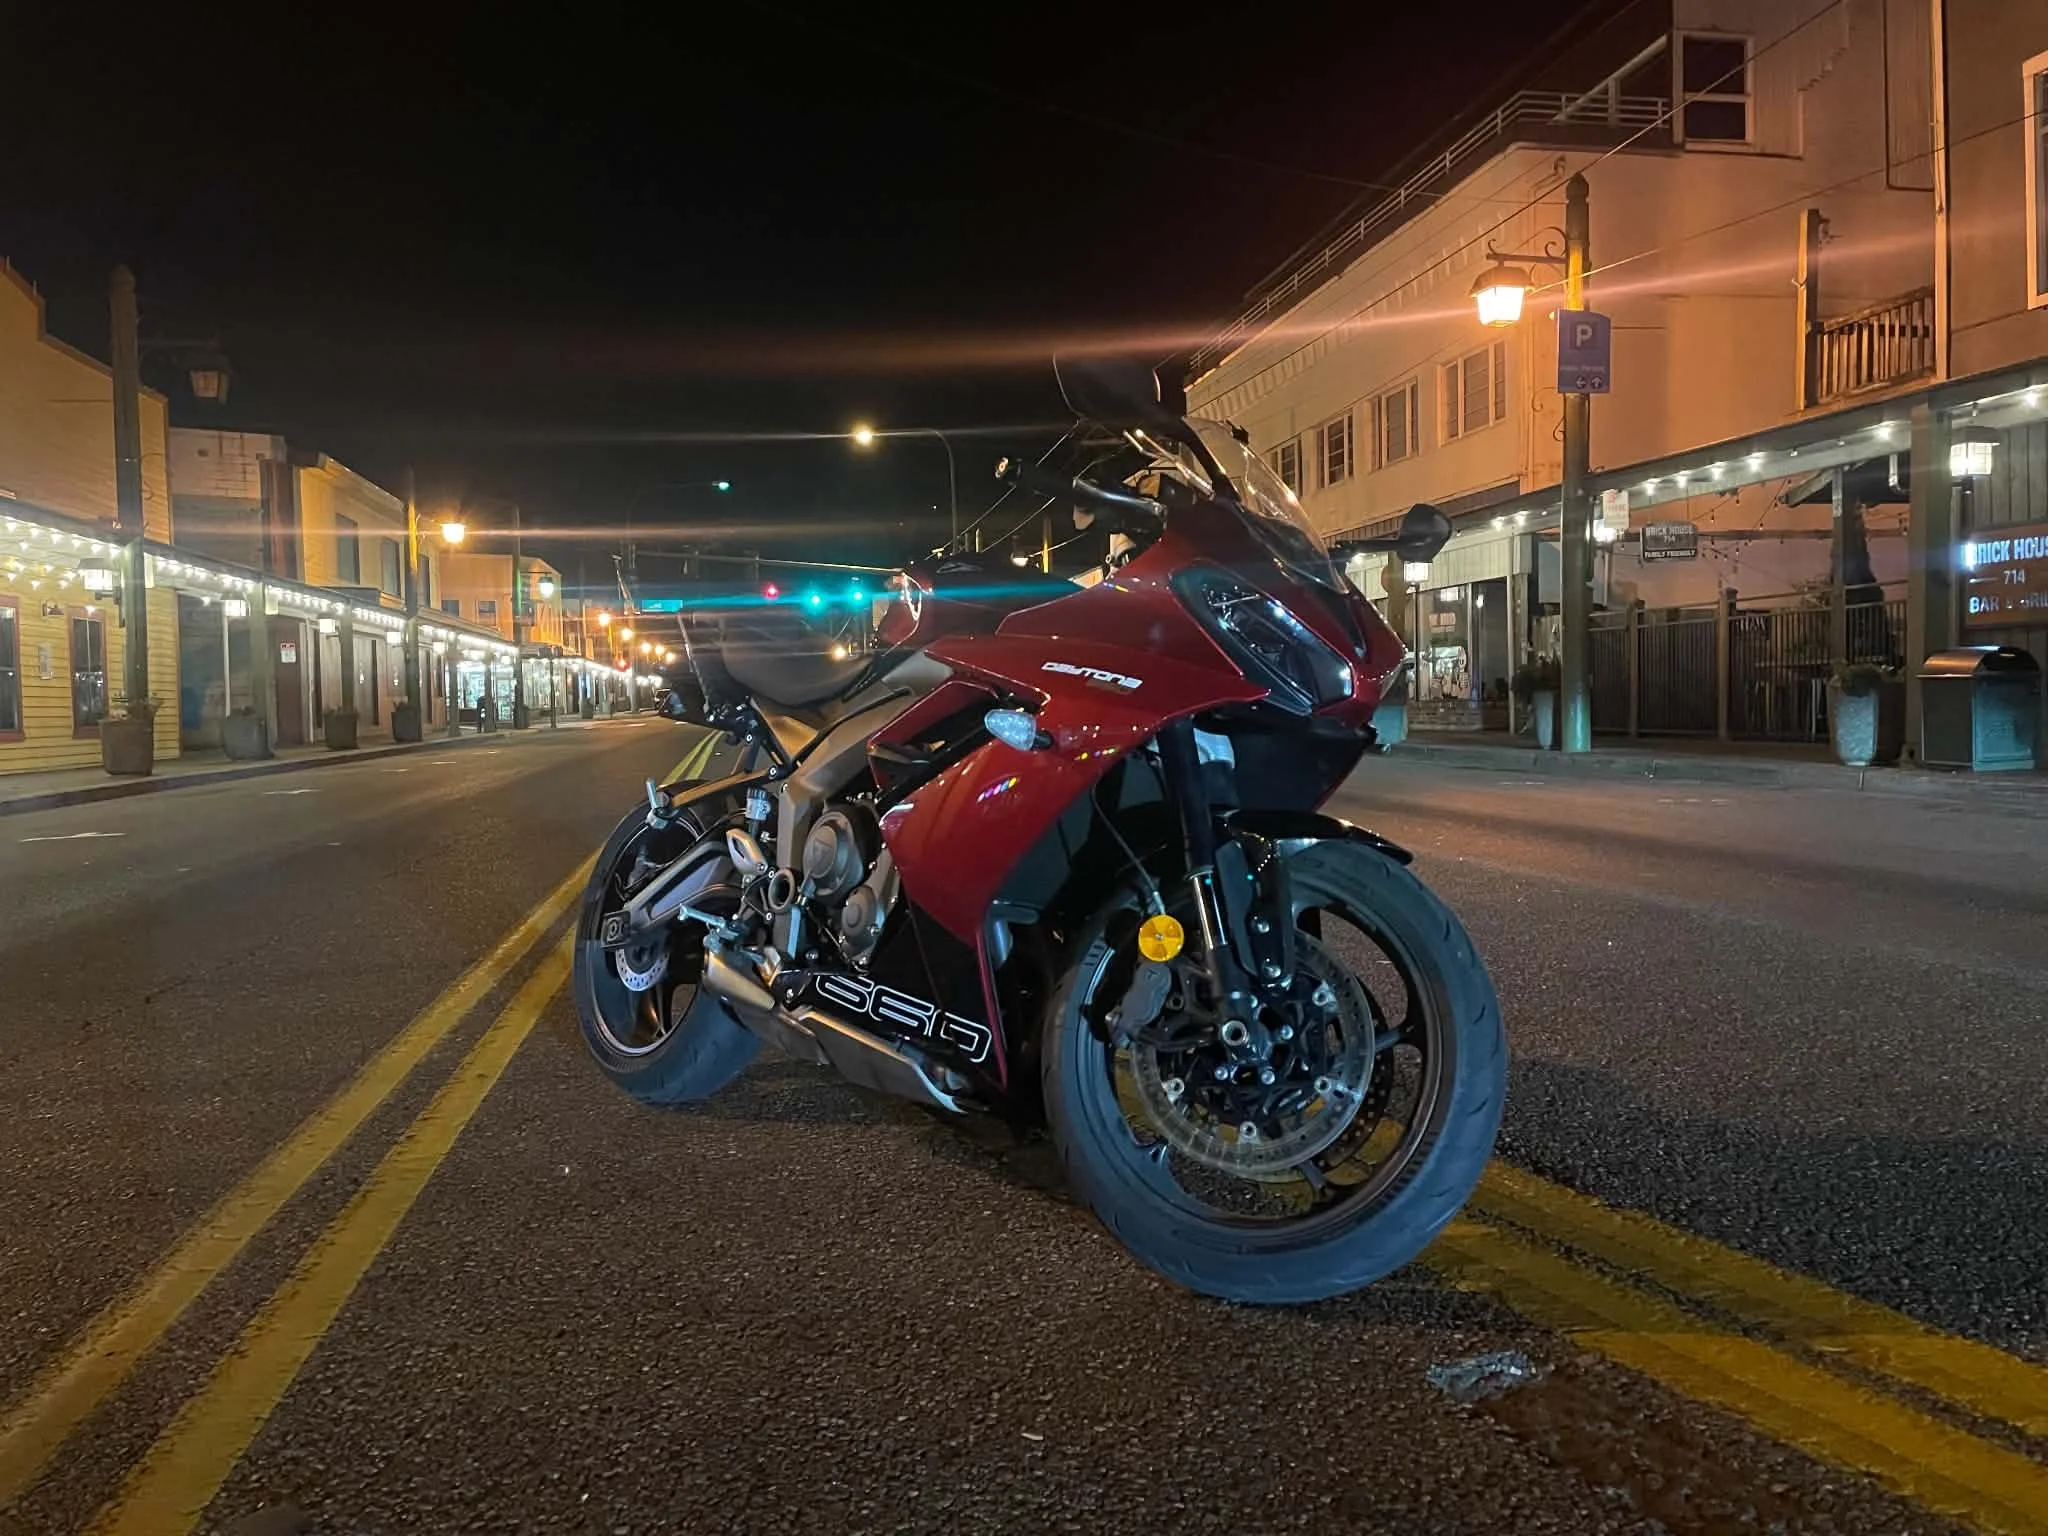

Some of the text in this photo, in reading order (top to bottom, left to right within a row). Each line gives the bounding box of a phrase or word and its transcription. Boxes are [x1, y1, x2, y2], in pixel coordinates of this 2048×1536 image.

[1575, 324, 1593, 347] P
[2003, 569, 2025, 585] 714
[1969, 596, 2000, 614] BAR
